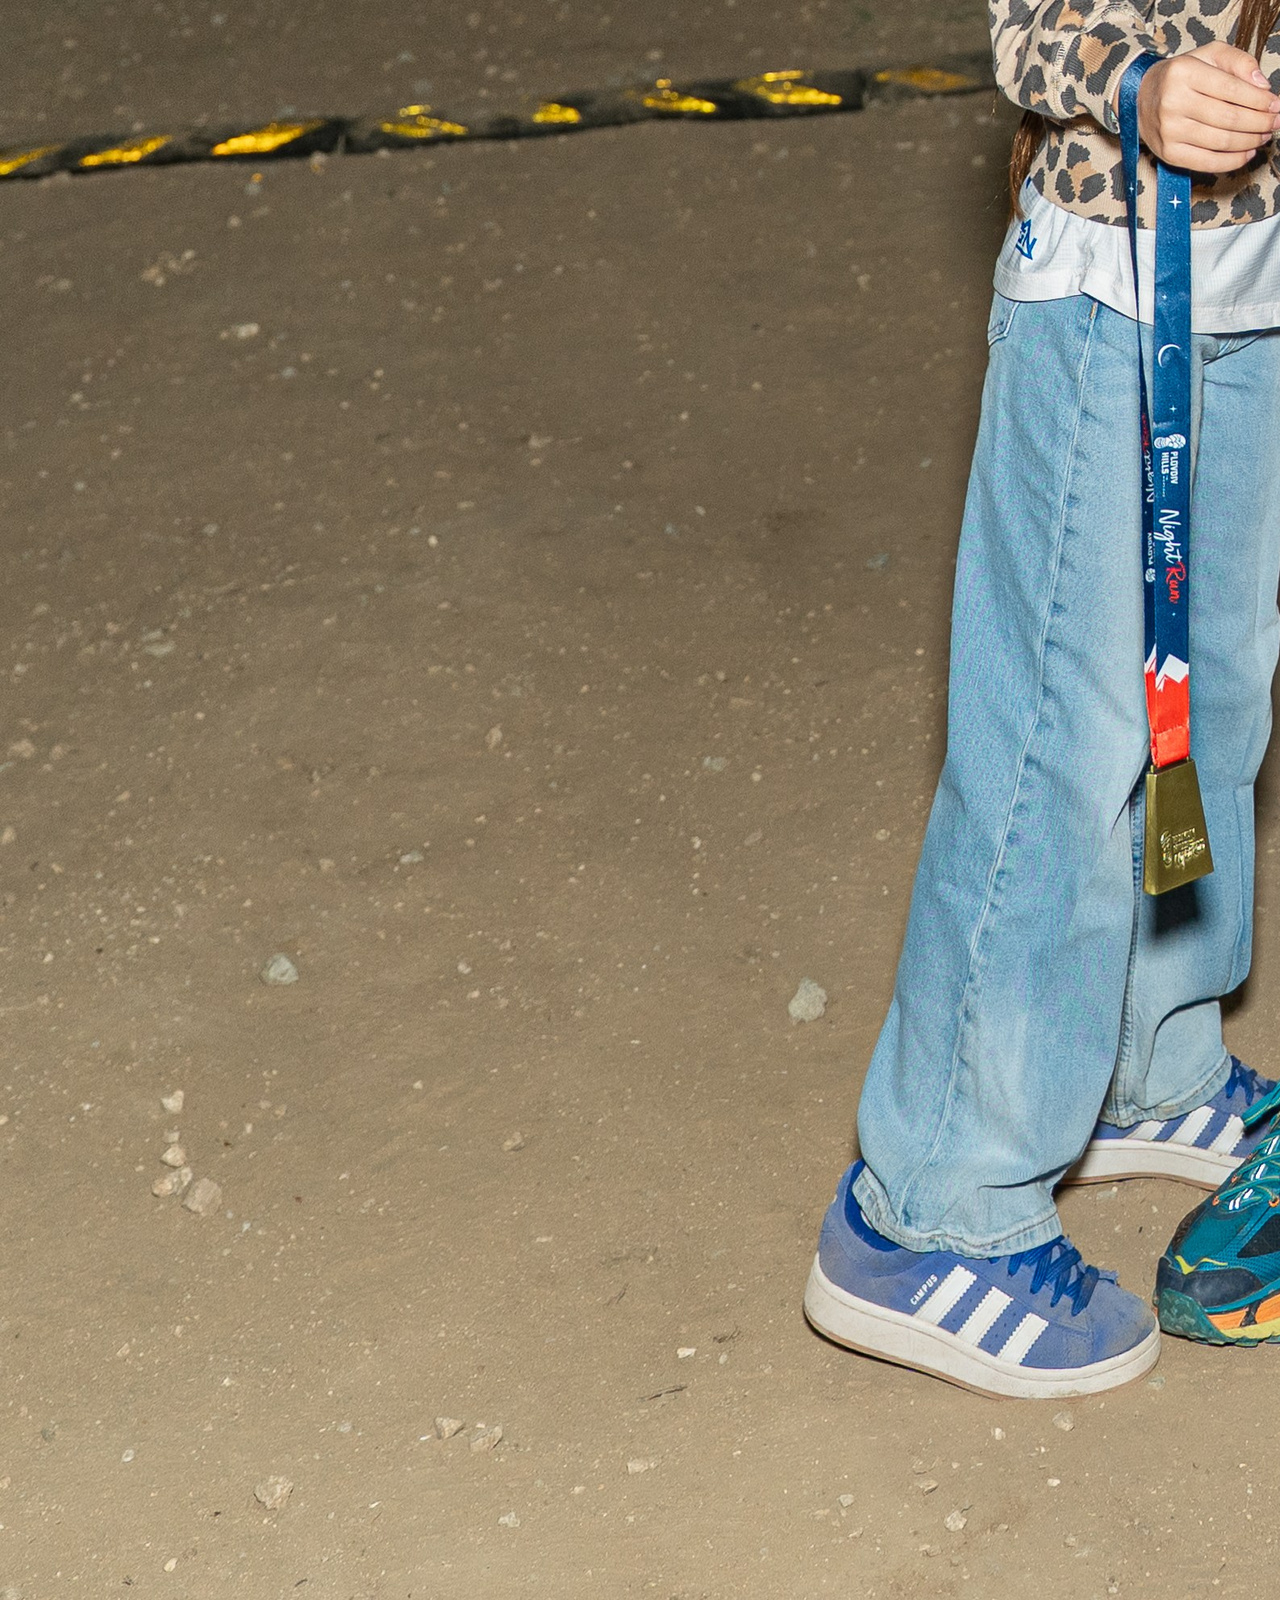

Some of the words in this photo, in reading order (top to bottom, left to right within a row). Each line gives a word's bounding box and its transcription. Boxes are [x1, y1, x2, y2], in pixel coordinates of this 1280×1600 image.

[1161, 451, 1170, 475] HILLS
[1169, 451, 1179, 485] PLOVDIV
[1153, 508, 1183, 564] Night
[1165, 560, 1187, 605] Run
[910, 1274, 938, 1305] CAMPUS
